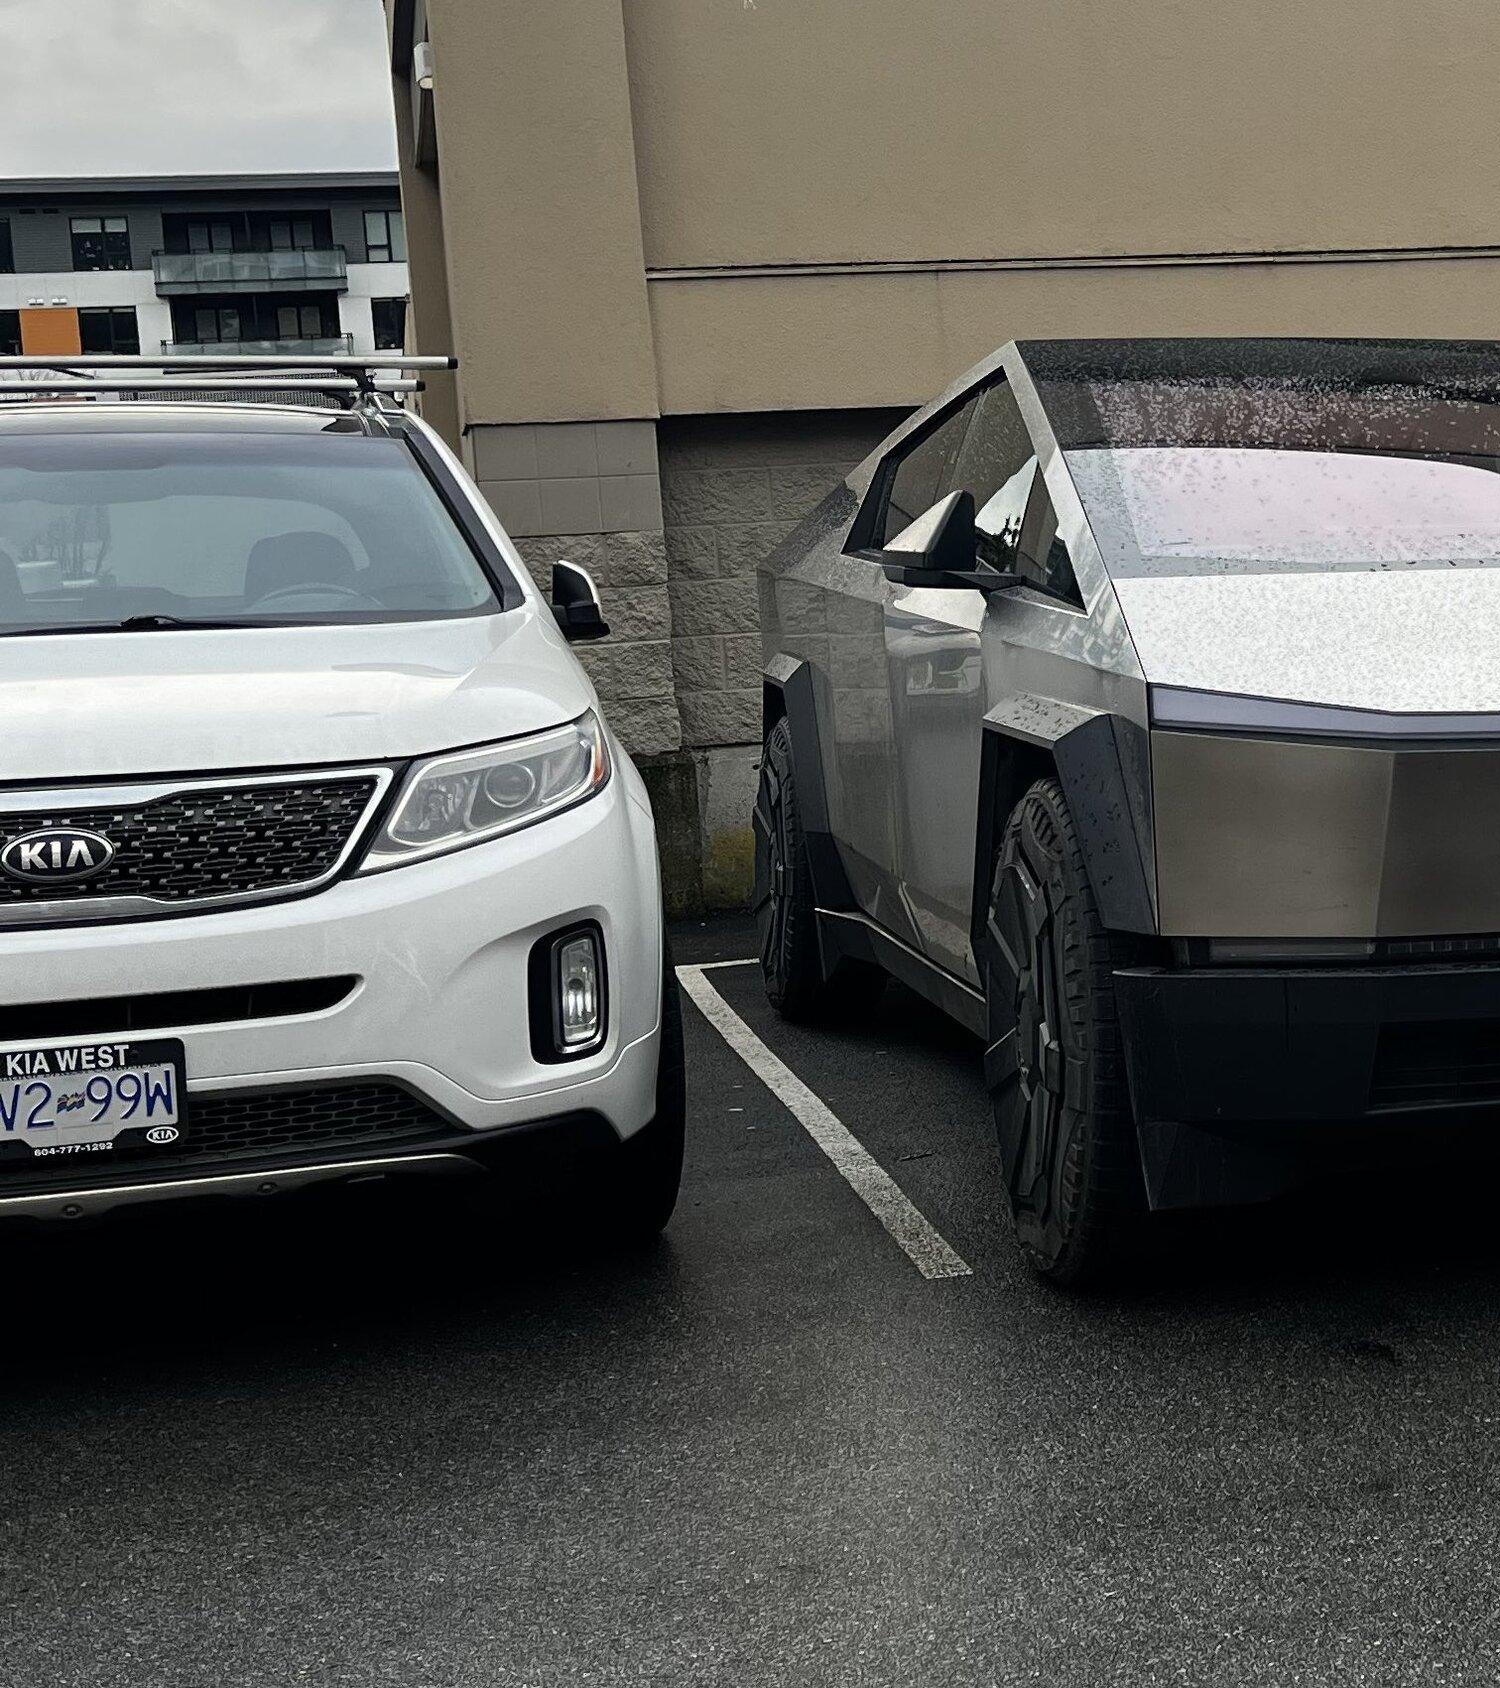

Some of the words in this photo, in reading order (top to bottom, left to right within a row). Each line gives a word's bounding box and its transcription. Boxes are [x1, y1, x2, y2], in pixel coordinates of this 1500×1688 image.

[19, 839, 95, 870] KIA
[5, 1051, 51, 1076] KIA
[55, 1044, 130, 1072] WEST
[151, 1130, 174, 1141] KIA
